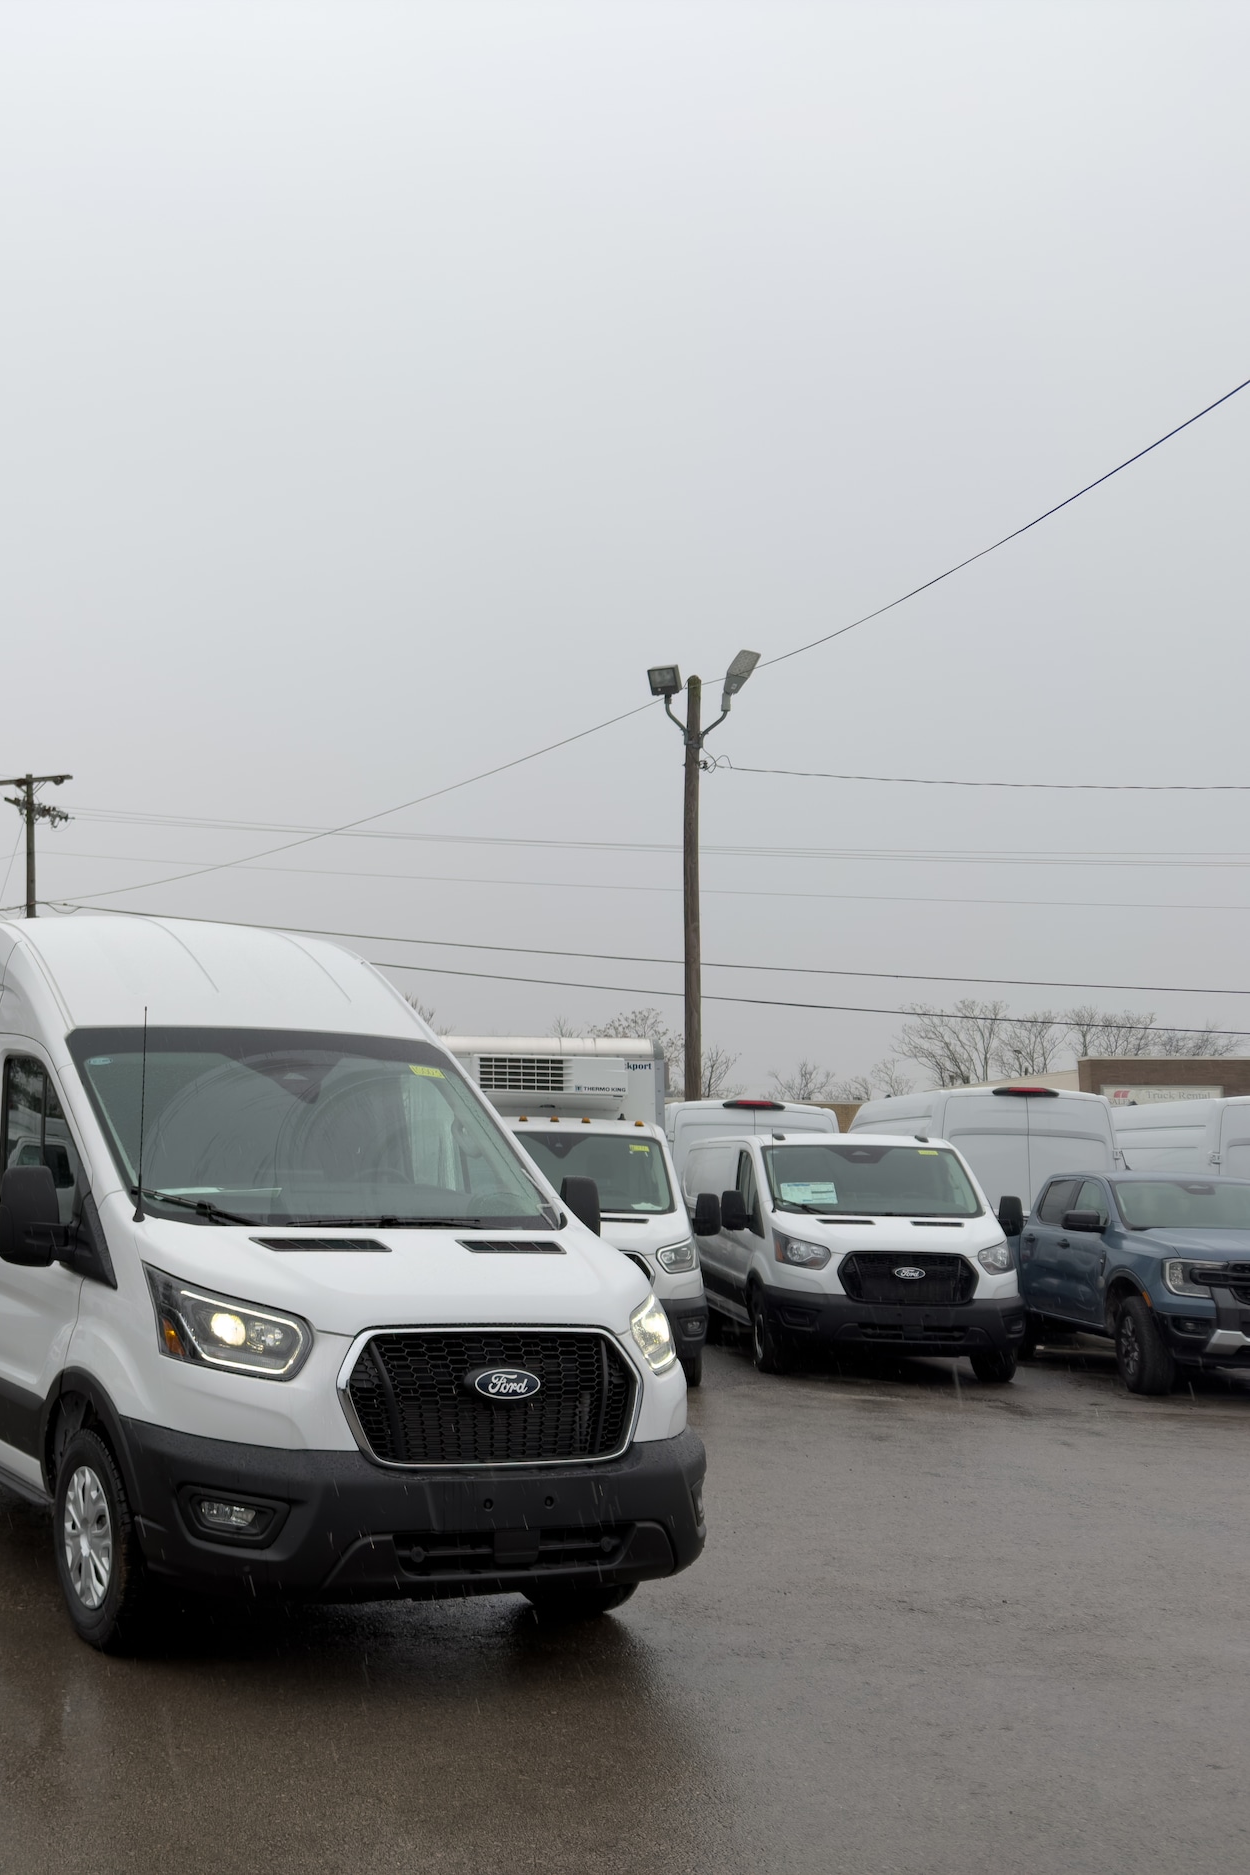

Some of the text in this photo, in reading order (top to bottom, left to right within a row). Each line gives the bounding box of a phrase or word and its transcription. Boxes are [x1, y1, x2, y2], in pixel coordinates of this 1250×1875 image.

[624, 1061, 652, 1071] kport
[1146, 1090, 1211, 1100] Truck Rental
[488, 1373, 528, 1393] Ford
